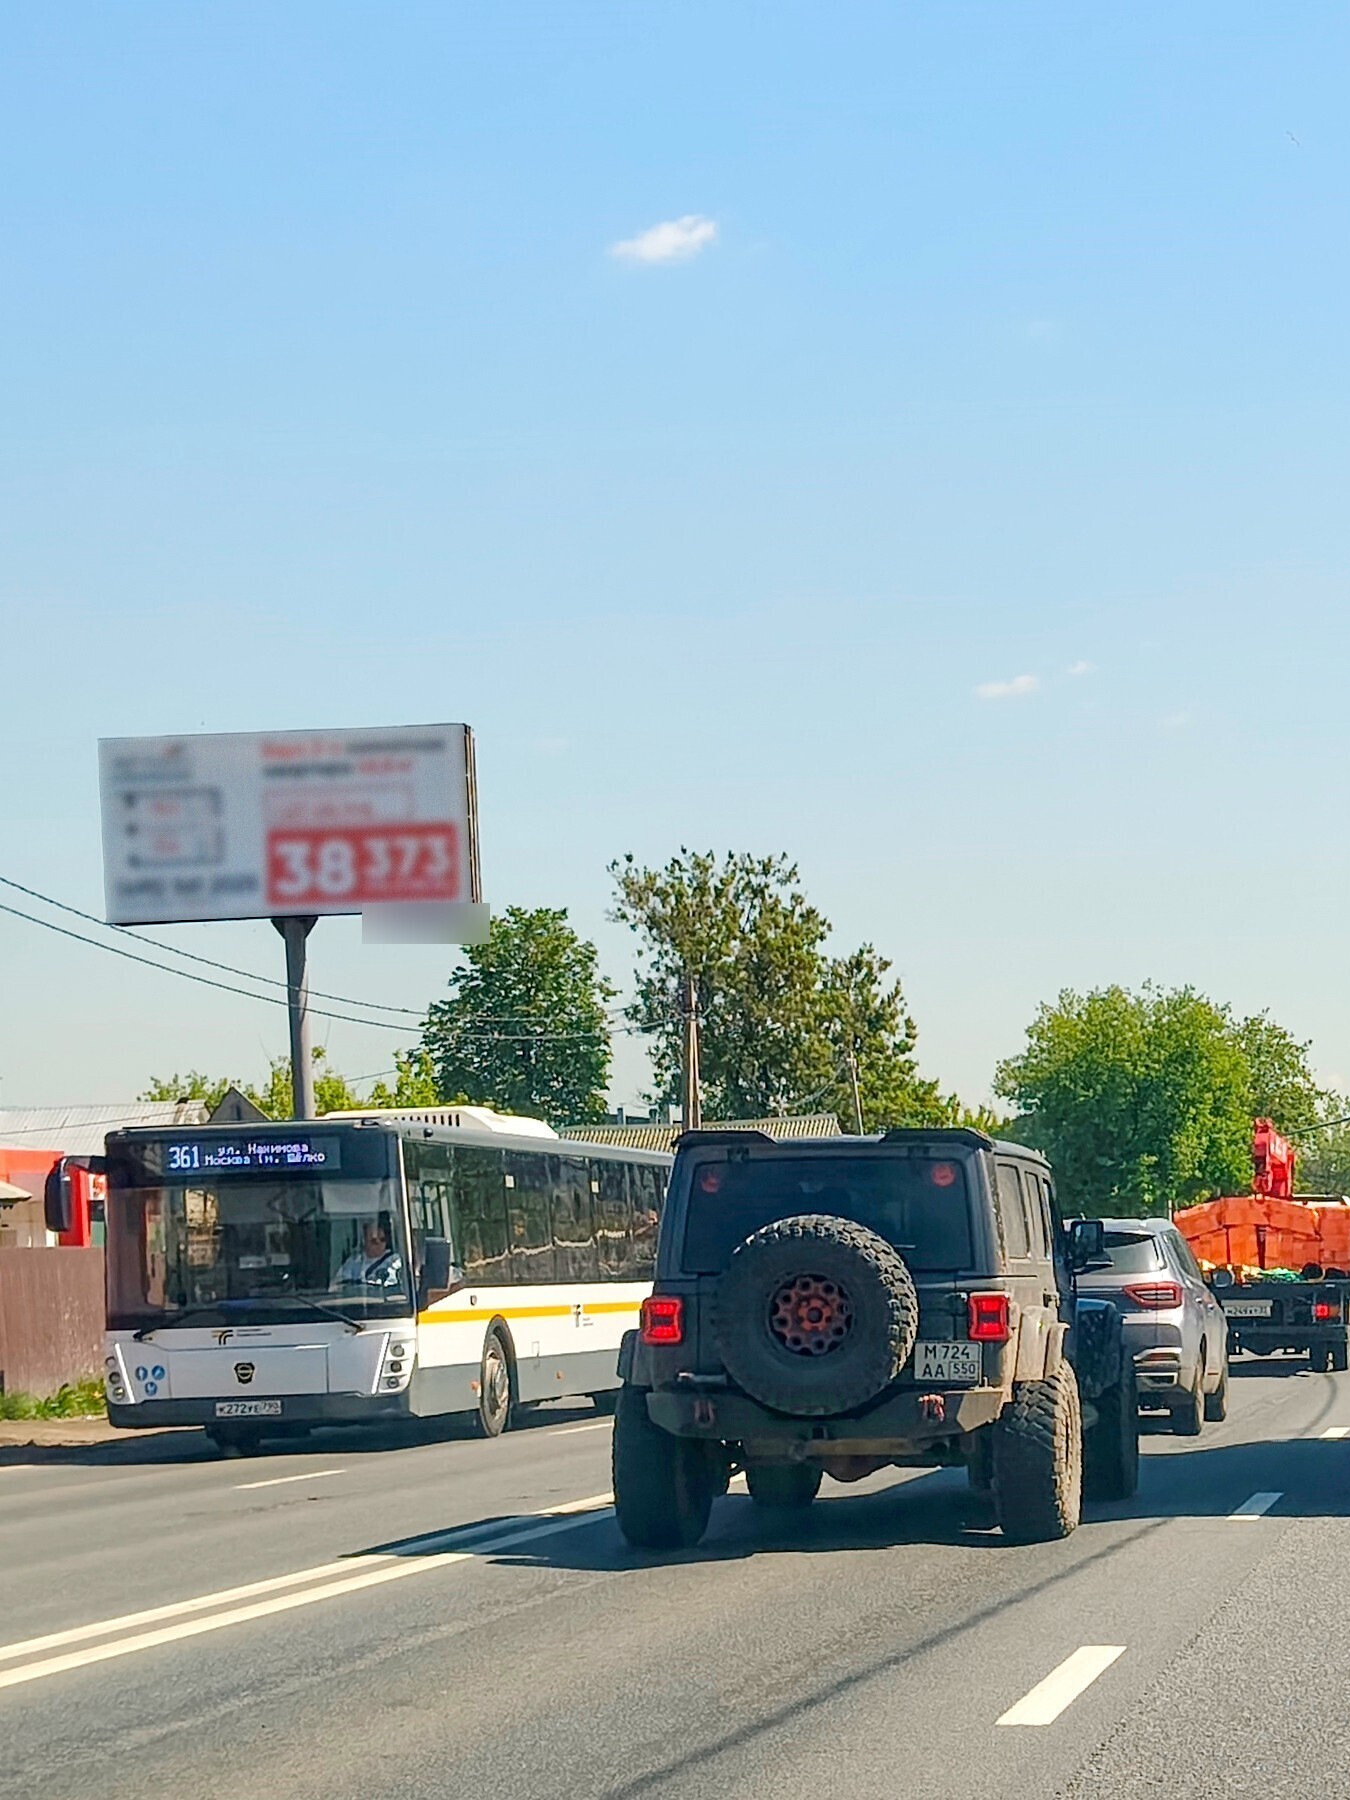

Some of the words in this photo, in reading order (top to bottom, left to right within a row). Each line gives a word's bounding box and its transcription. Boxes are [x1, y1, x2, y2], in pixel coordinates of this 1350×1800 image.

[168, 1145, 200, 1168] 361
[922, 1363, 945, 1378] АА
[953, 1363, 976, 1374] 550
